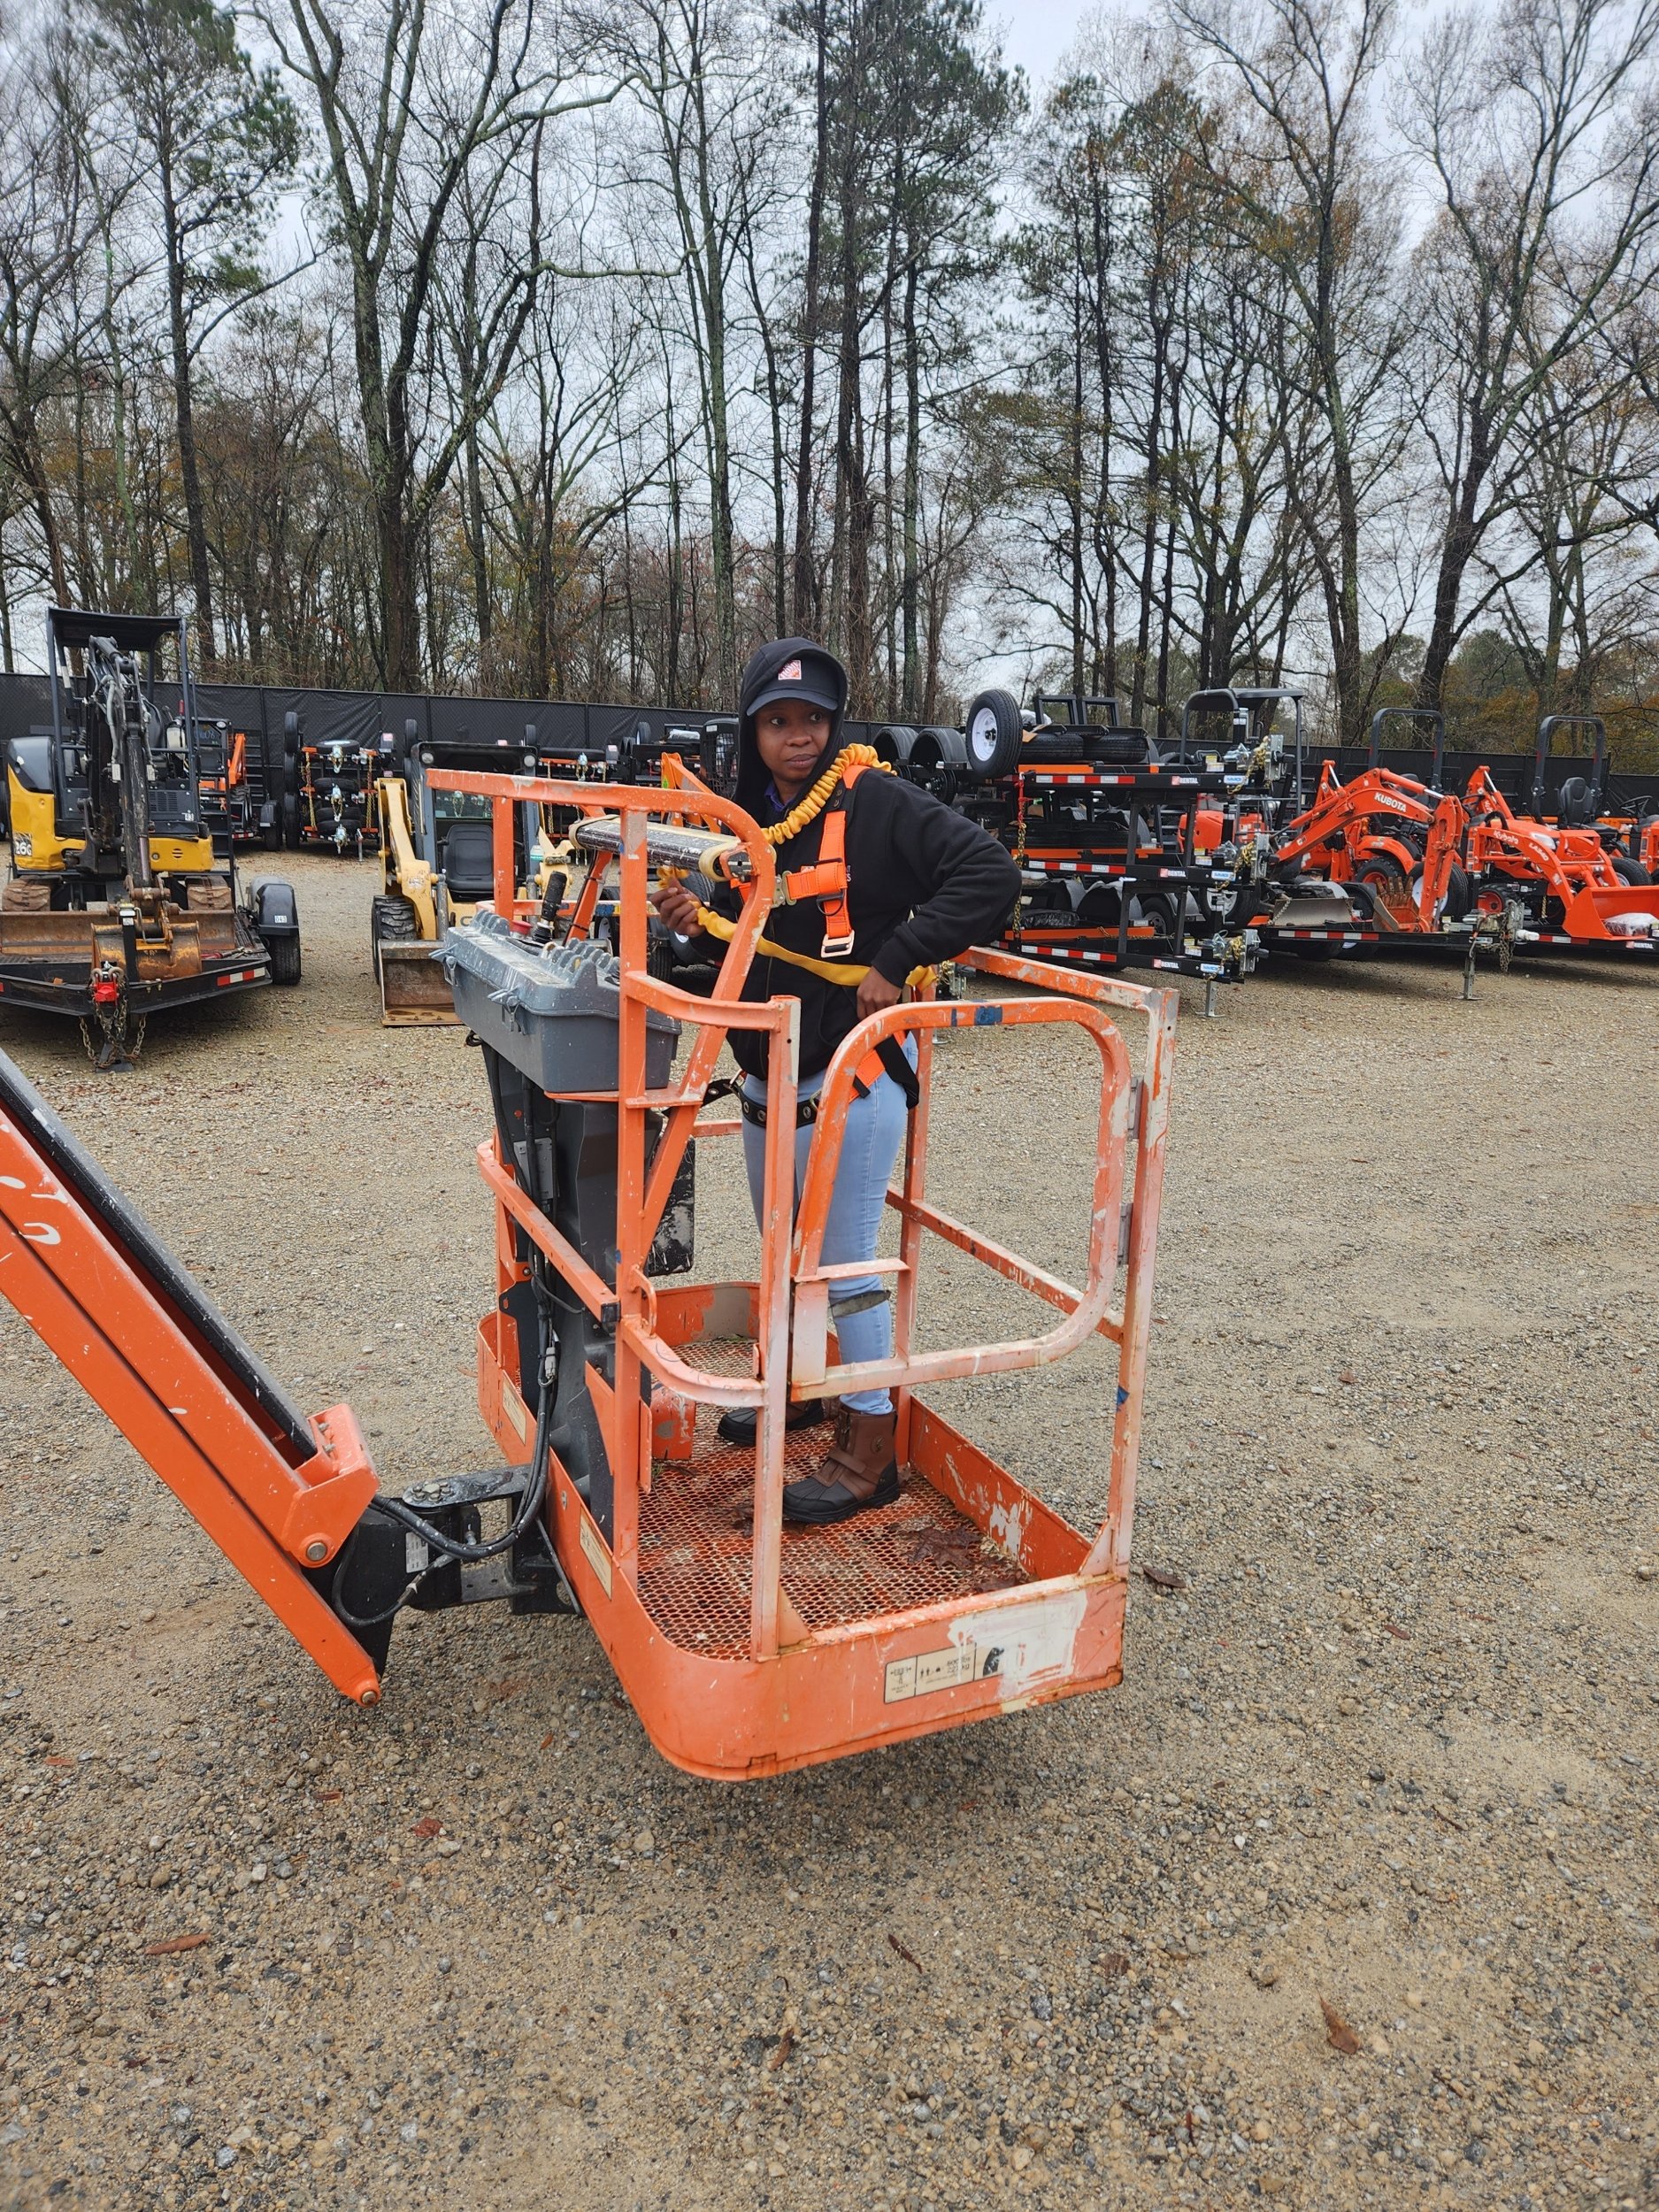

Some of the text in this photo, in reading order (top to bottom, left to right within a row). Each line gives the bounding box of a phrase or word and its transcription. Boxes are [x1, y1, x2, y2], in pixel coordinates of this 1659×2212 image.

[1374, 792, 1407, 812] KUBOTA
[1494, 830, 1519, 845] Kubota
[1167, 869, 1187, 878] RENTAL
[1161, 961, 1180, 970] RENTAL
